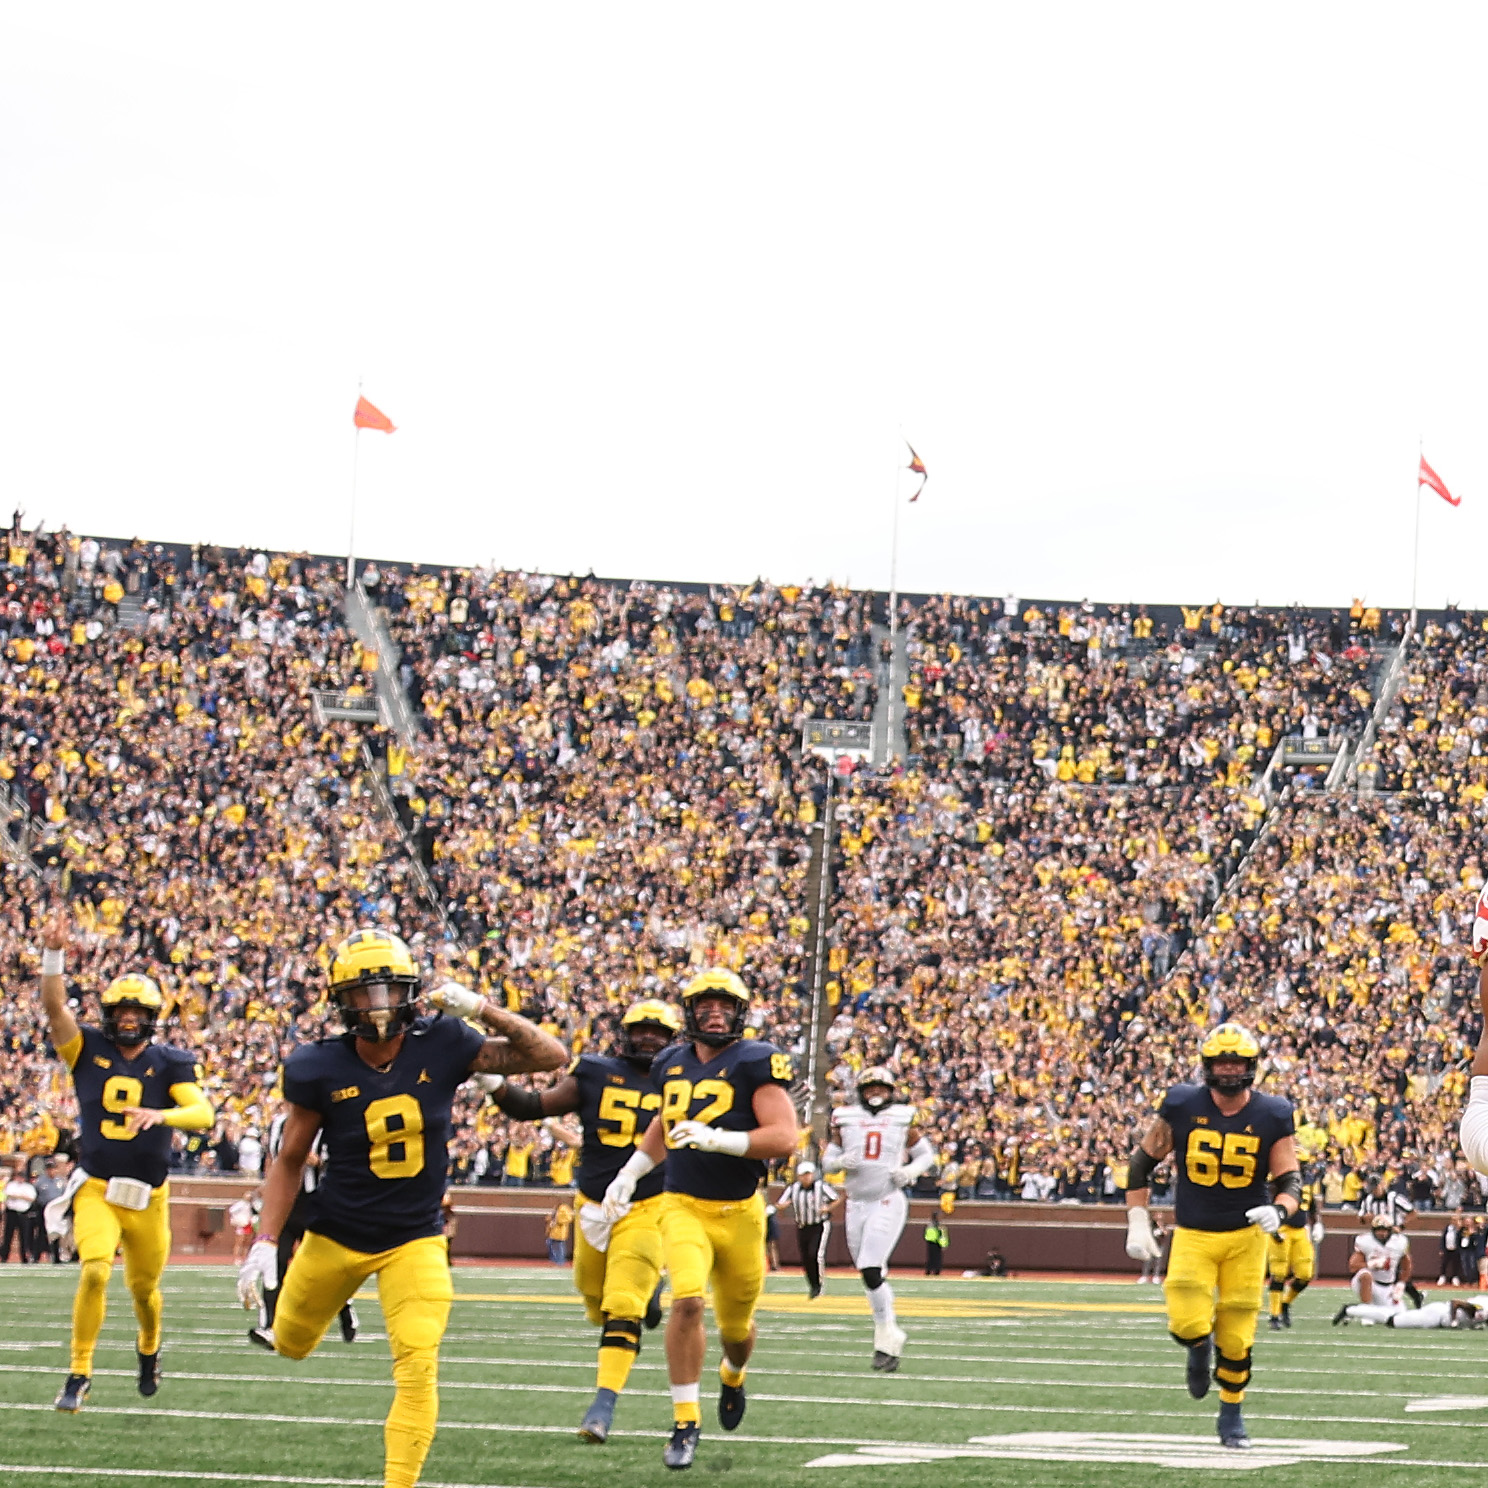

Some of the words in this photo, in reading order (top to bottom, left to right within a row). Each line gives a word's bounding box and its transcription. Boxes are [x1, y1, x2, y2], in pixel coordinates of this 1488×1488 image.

[100, 1075, 144, 1141] 9
[363, 1093, 426, 1180] 8
[864, 1131, 882, 1160] 0
[1185, 1127, 1262, 1190] 65
